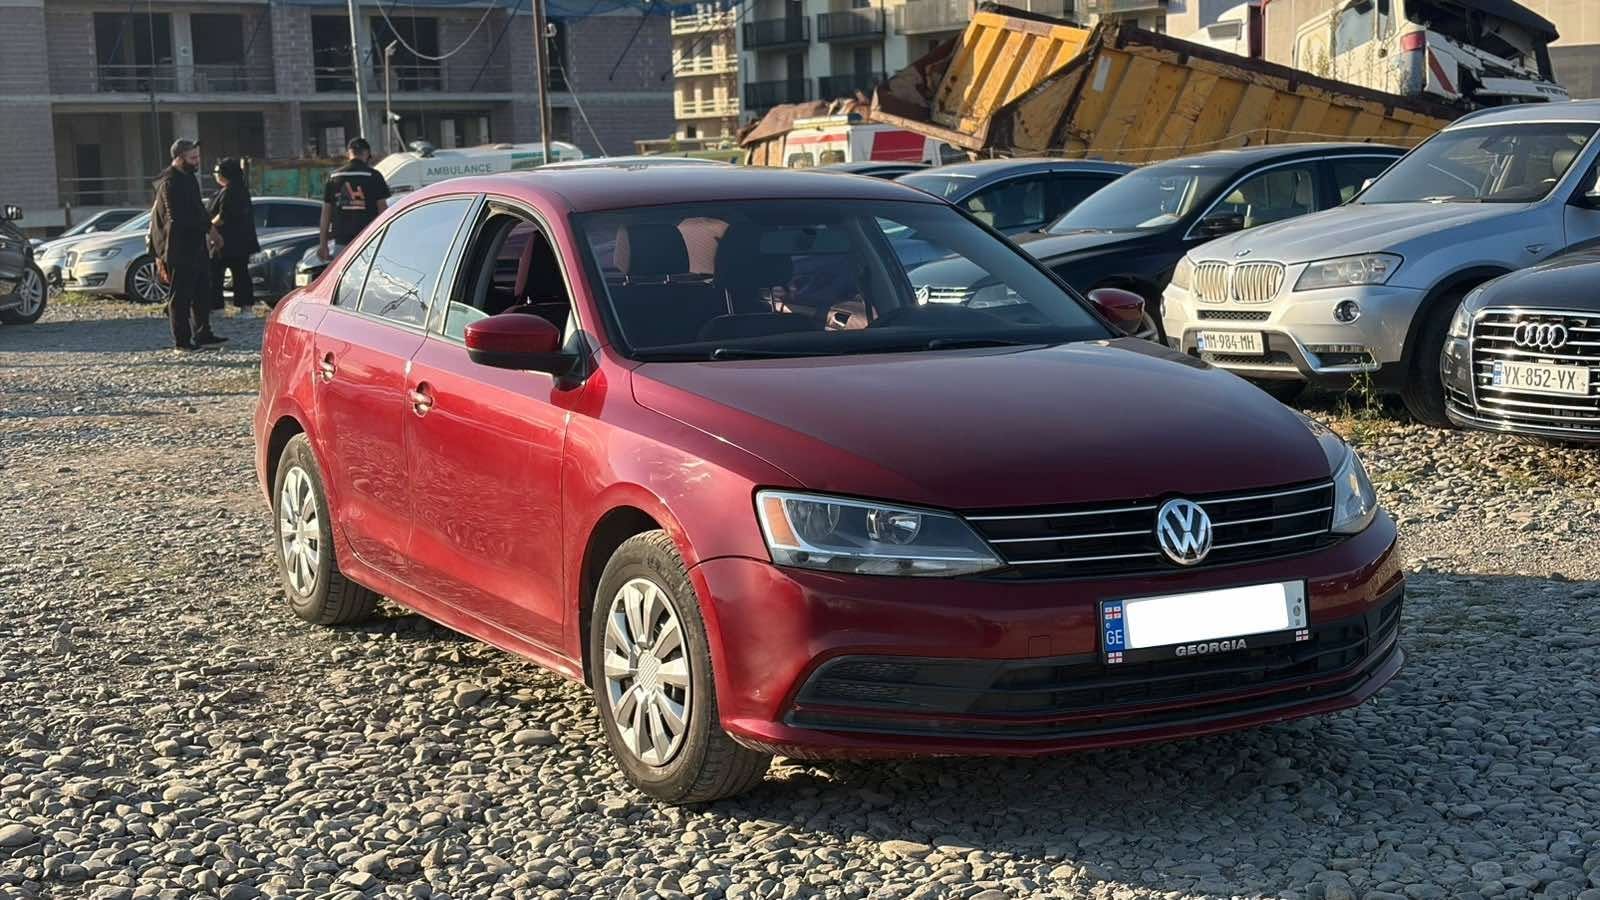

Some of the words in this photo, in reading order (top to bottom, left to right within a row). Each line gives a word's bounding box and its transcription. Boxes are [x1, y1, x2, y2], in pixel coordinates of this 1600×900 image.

[426, 163, 492, 176] AMBULANCE
[1504, 366, 1576, 390] YX-852-YX
[1105, 629, 1123, 645] GE
[1175, 638, 1247, 657] GEORGIA
